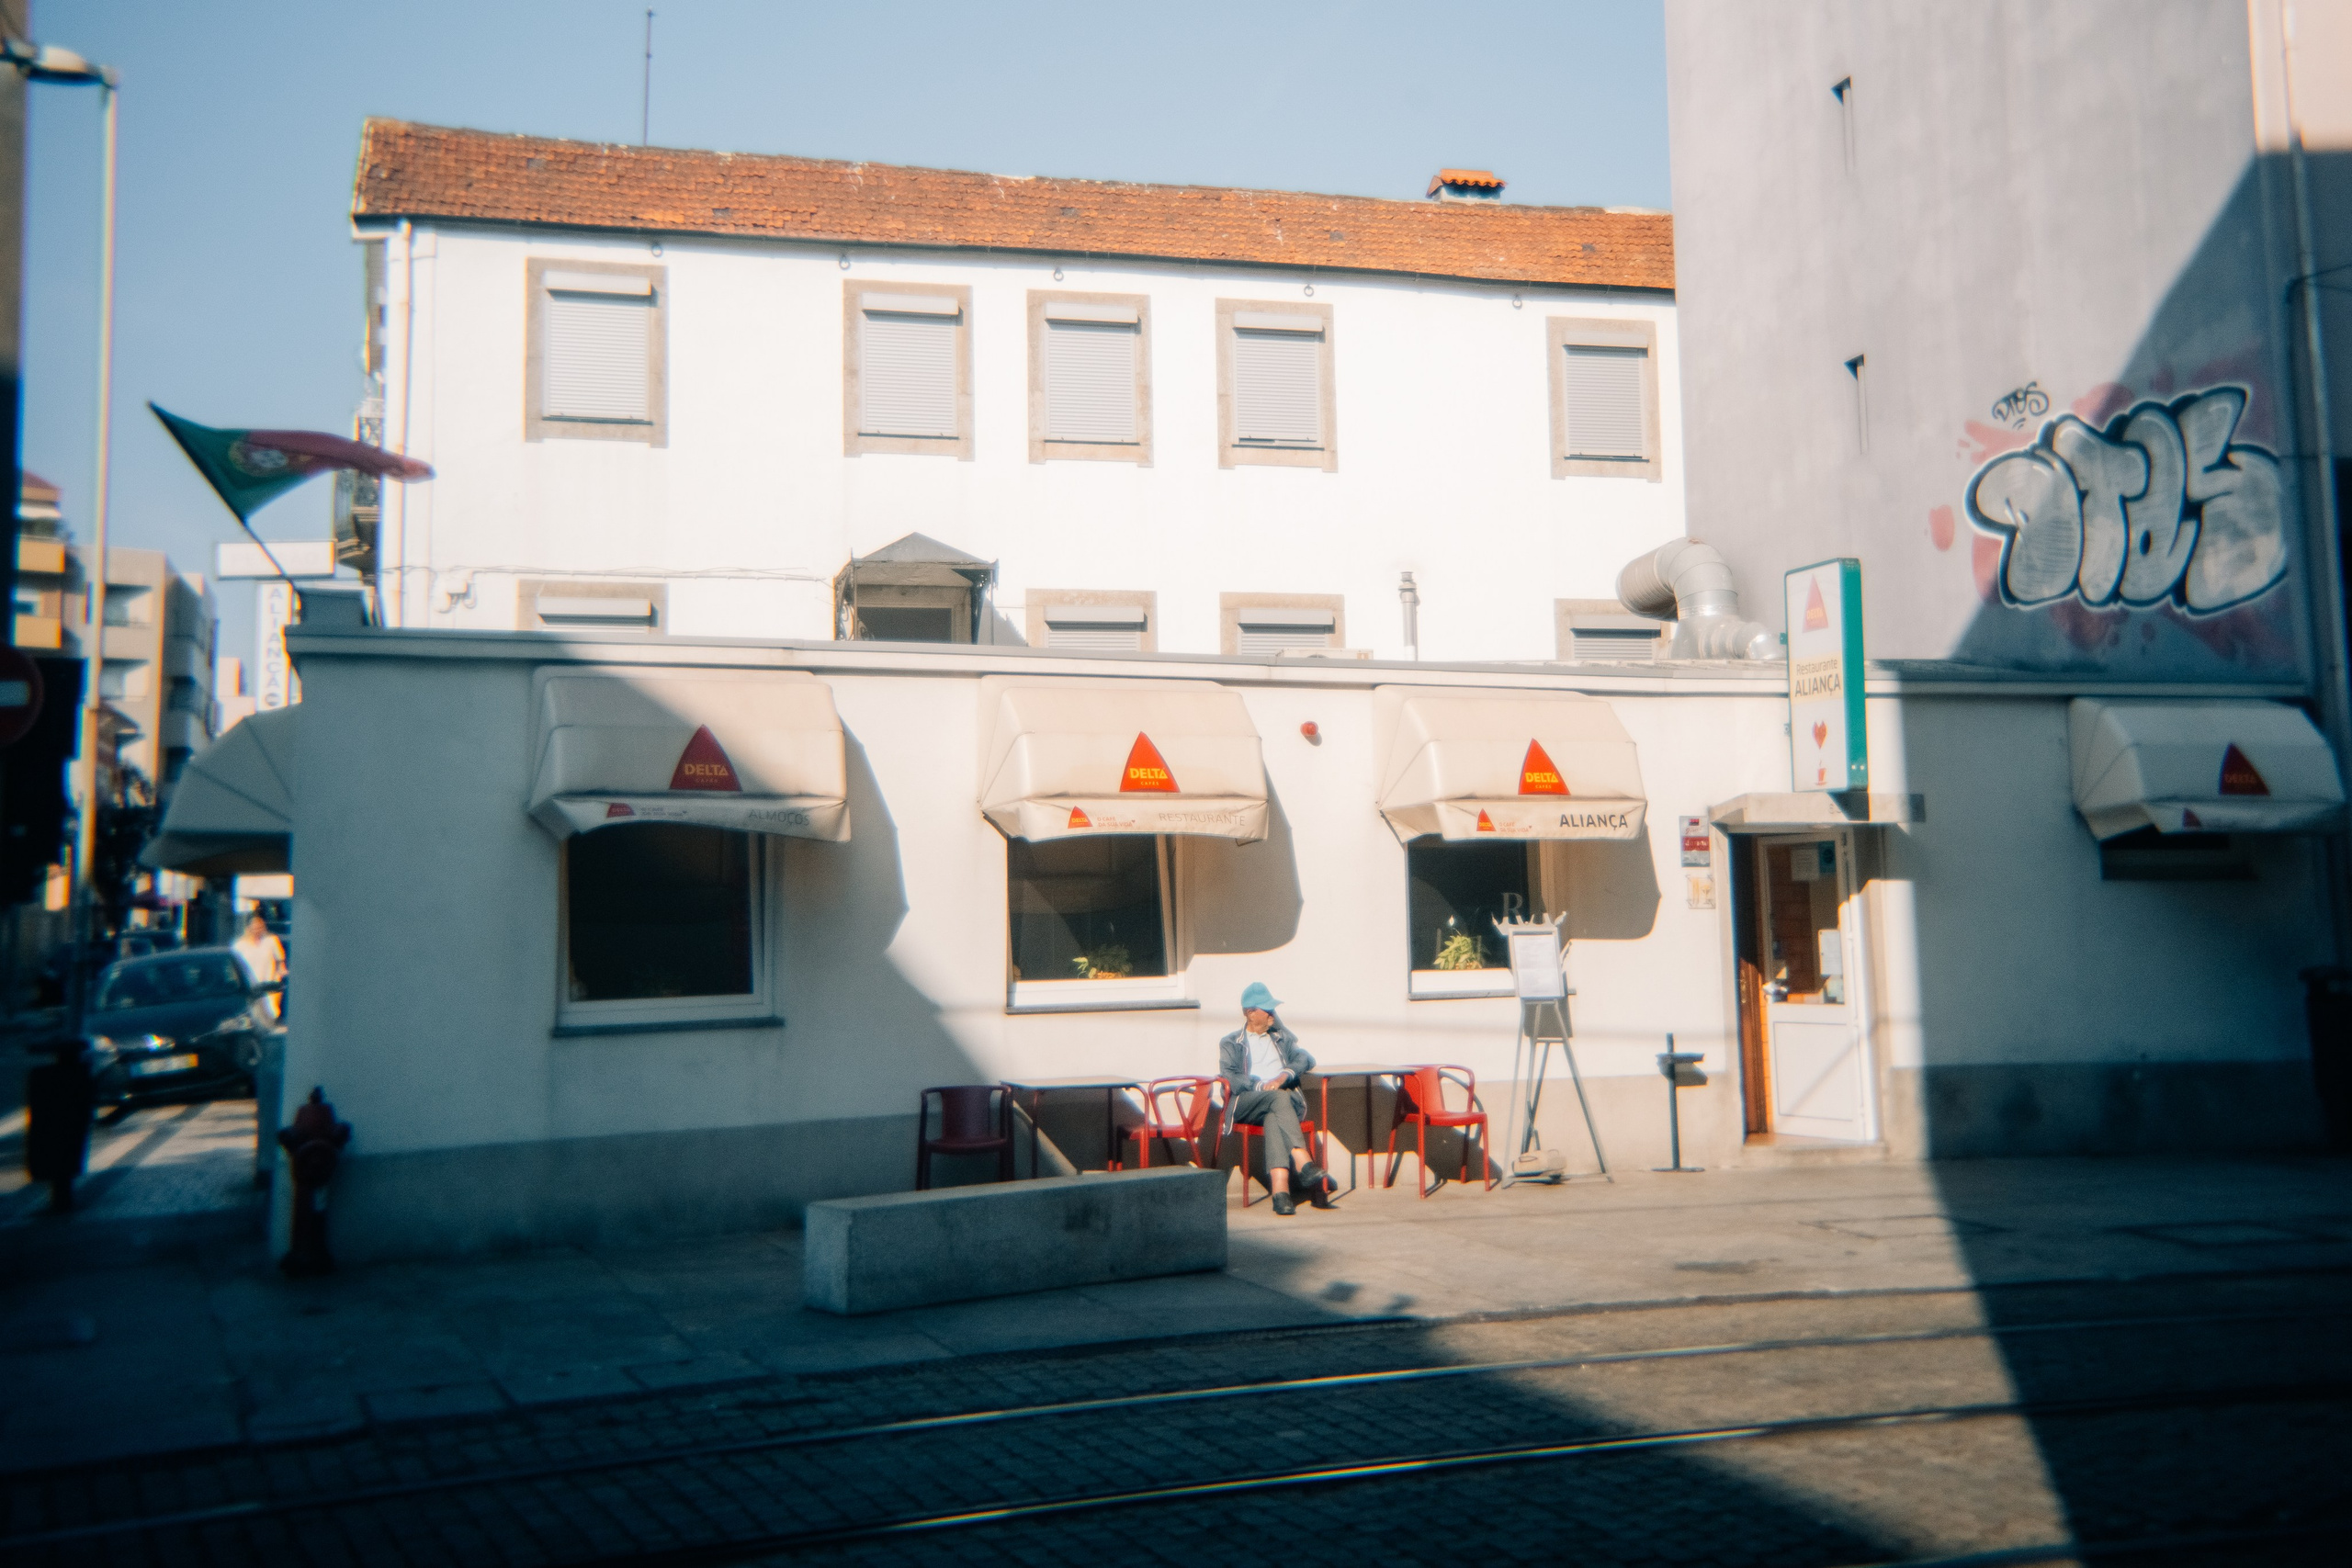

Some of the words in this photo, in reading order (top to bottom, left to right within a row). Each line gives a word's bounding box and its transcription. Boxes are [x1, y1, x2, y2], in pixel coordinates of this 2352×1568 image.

[1796, 659, 1838, 676] Restaurante
[1795, 673, 1841, 697] ALIANÇA
[684, 763, 729, 777] DELTA
[1130, 767, 1168, 779] DELTA
[1525, 772, 1559, 783] DELTA
[749, 808, 810, 827] ALMOÇOS
[1159, 813, 1246, 827] RESTAURANTE
[1559, 814, 1628, 830] ALIANÇA
